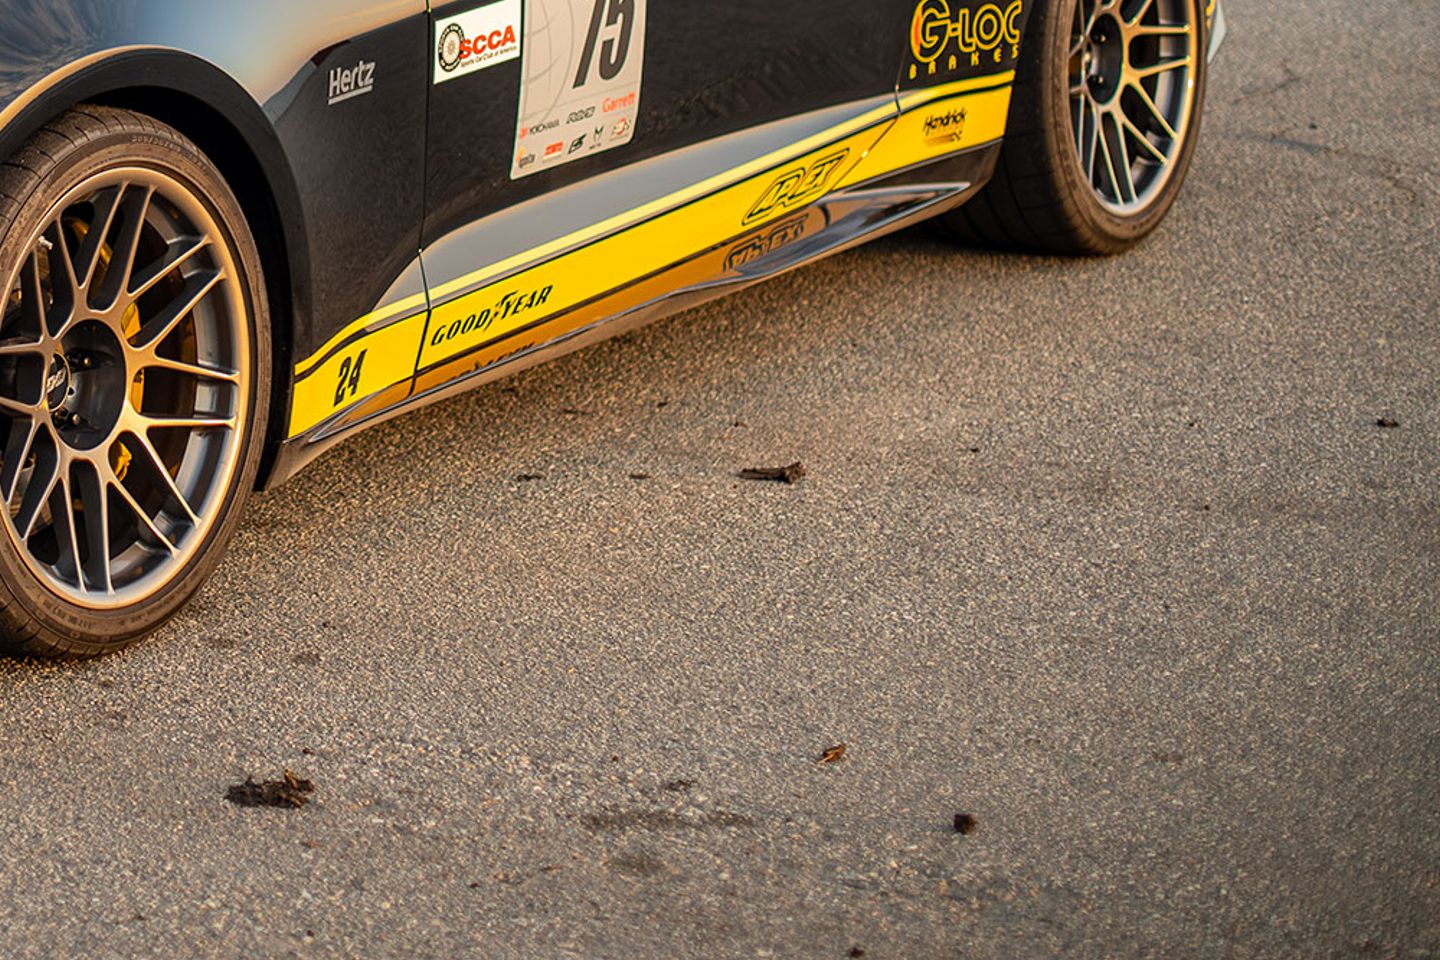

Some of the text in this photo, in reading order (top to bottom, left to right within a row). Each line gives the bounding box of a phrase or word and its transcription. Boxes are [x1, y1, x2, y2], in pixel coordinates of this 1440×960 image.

[459, 25, 516, 59] SCCA
[329, 60, 376, 98] Hertz
[602, 92, 636, 113] Garrett
[430, 284, 554, 347] GOODYEAR
[333, 348, 368, 408] 24
